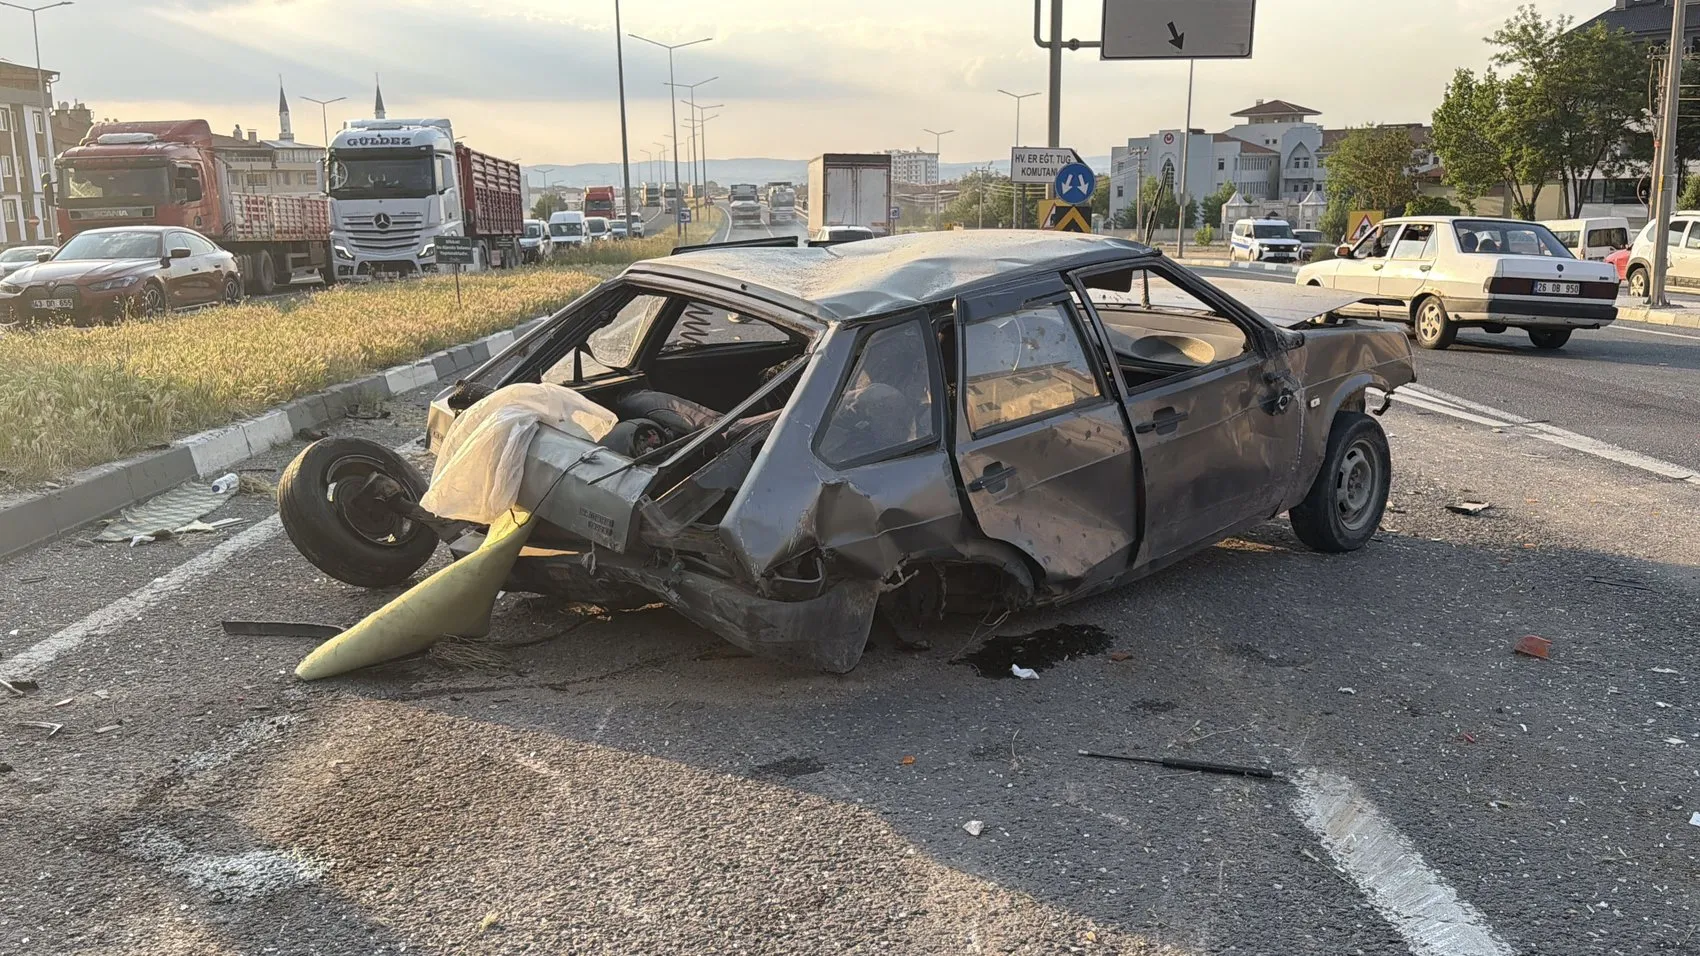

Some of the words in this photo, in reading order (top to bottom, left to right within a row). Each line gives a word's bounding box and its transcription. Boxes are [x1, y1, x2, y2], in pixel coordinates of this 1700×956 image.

[347, 136, 411, 146] GÜLDEZ
[1015, 154, 1026, 163] HV.
[1028, 154, 1038, 163] ER
[1039, 153, 1055, 164] EĞT.
[1538, 283, 1547, 292] 26
[1565, 284, 1579, 293] 950
